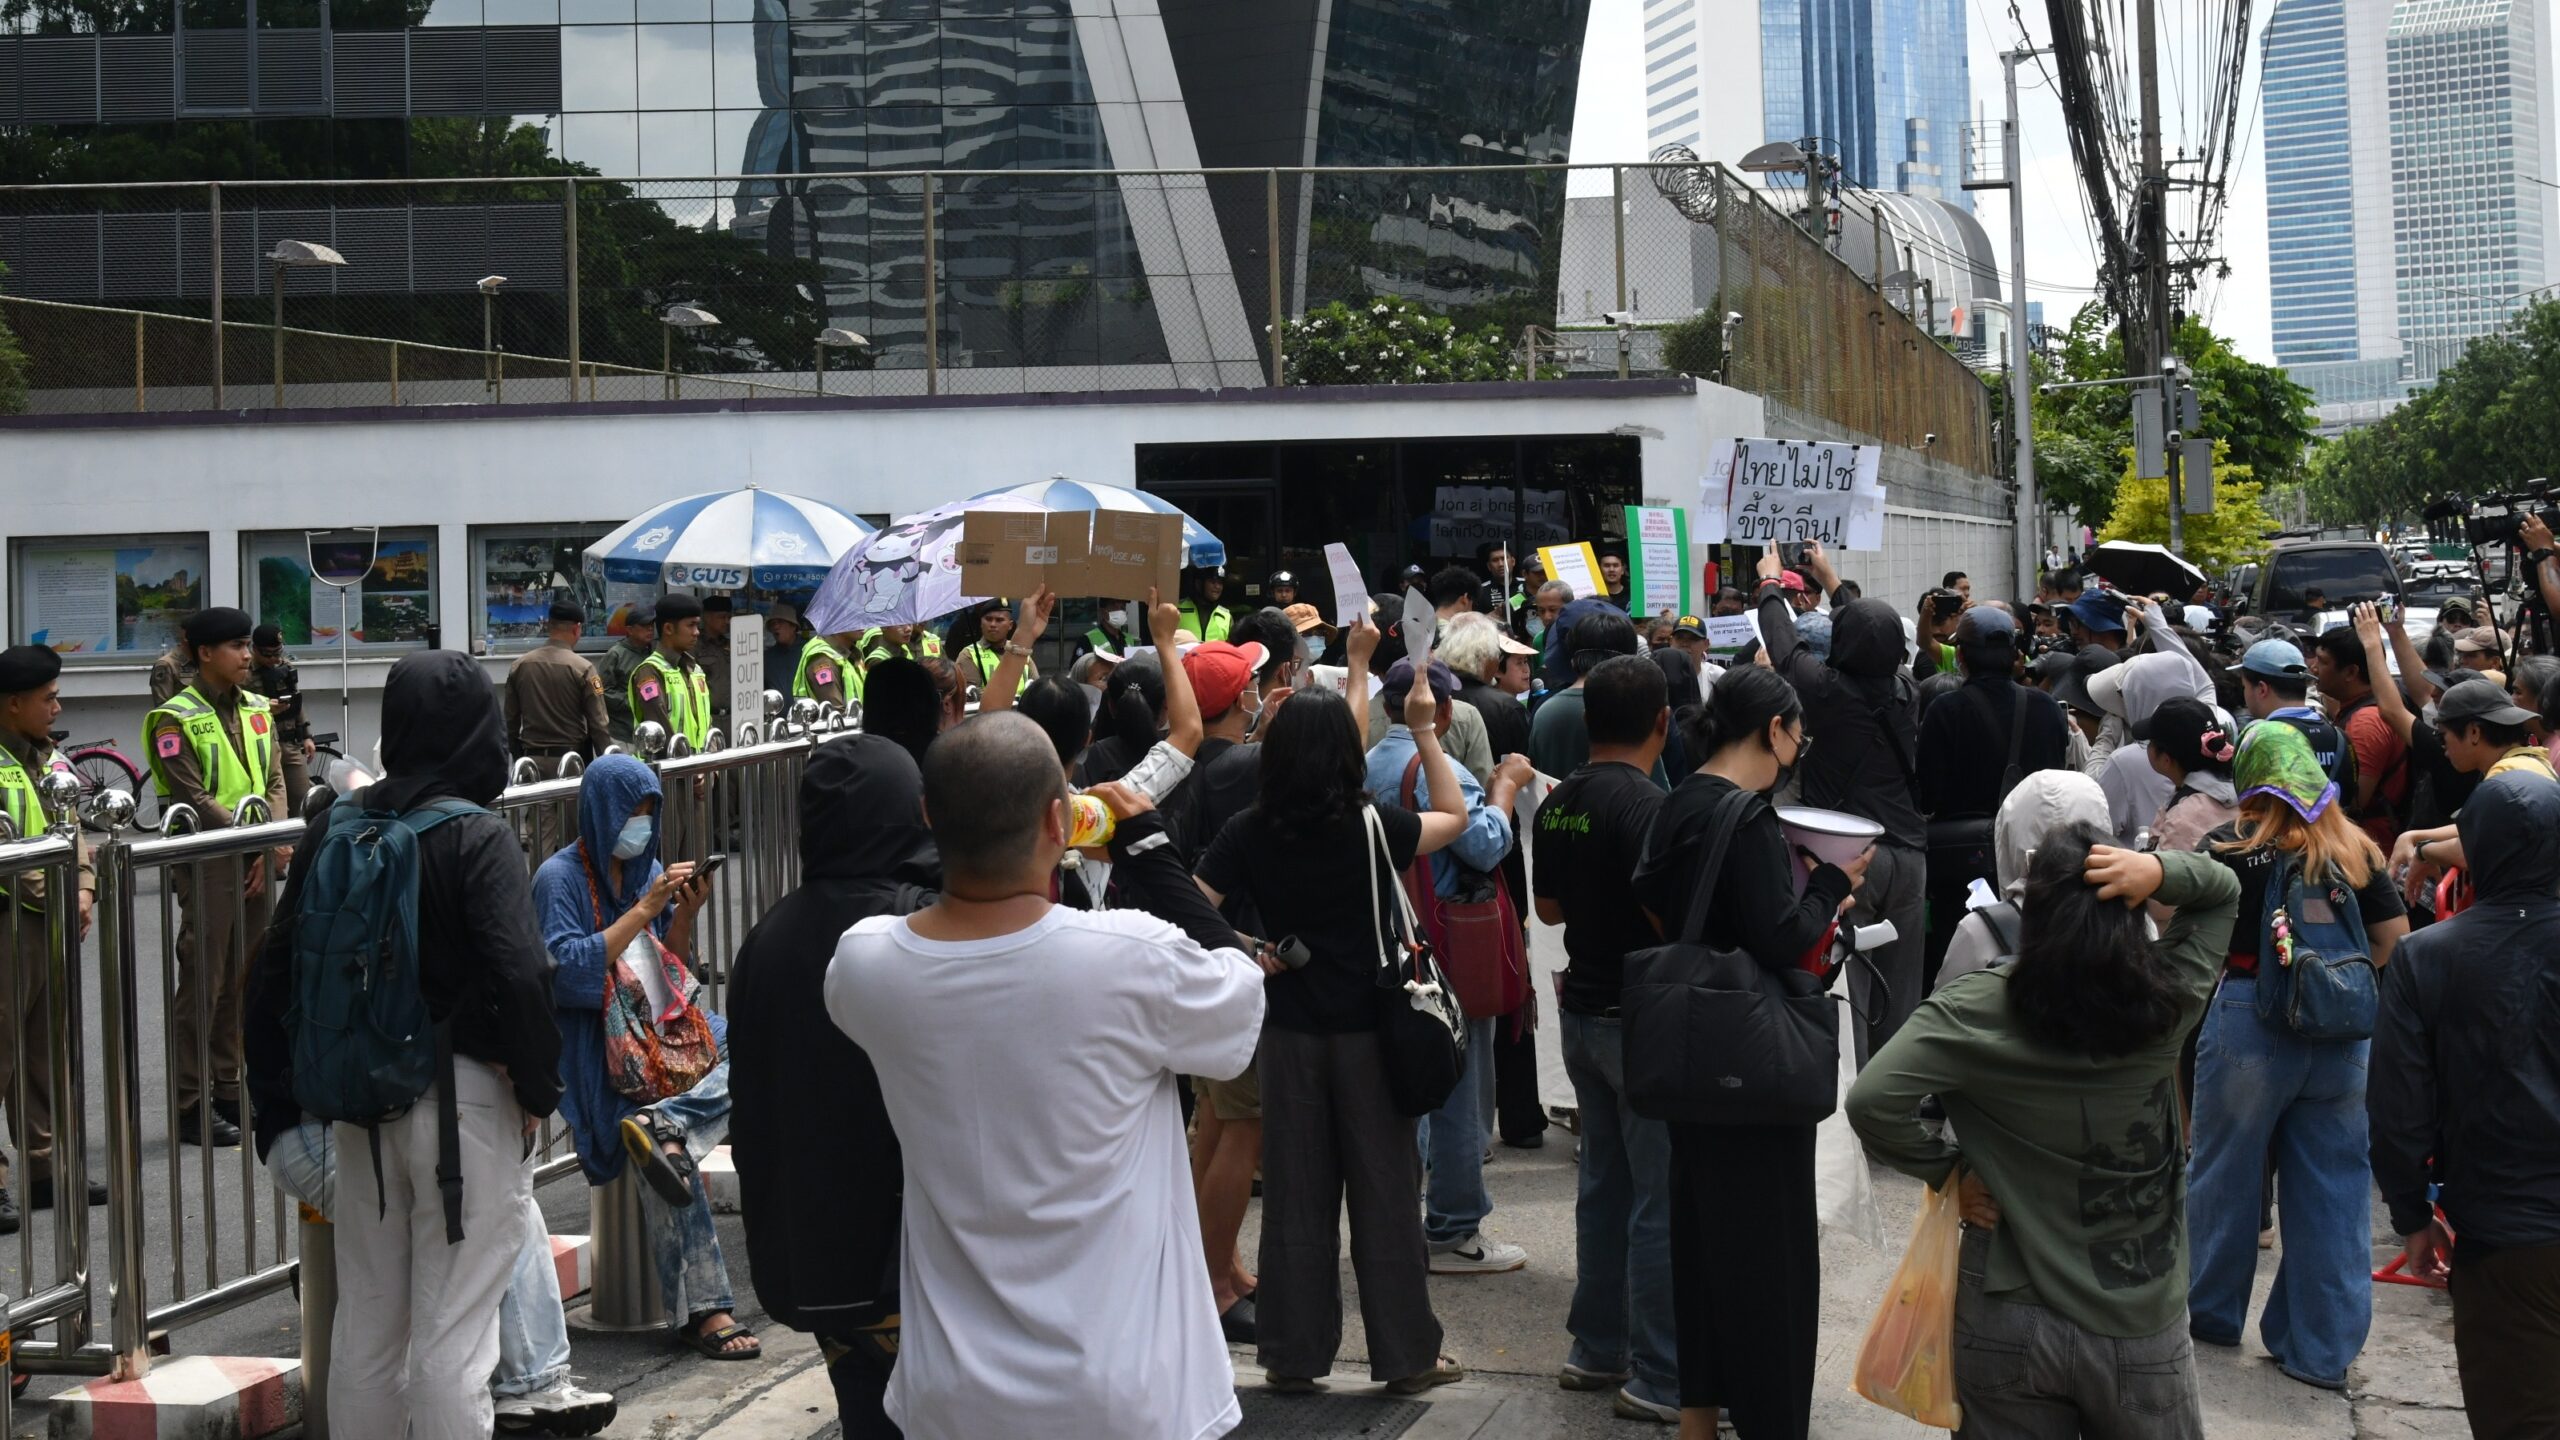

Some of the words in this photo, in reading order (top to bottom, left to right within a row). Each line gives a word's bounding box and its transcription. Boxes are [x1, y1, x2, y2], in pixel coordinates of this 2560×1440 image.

[1735, 443, 1855, 491] ไทยไม่ใช่
[1737, 491, 1841, 544] ขี้ข้าจีน!
[691, 566, 742, 585] GUTS
[736, 662, 760, 685] OUT
[737, 689, 760, 711] ออก
